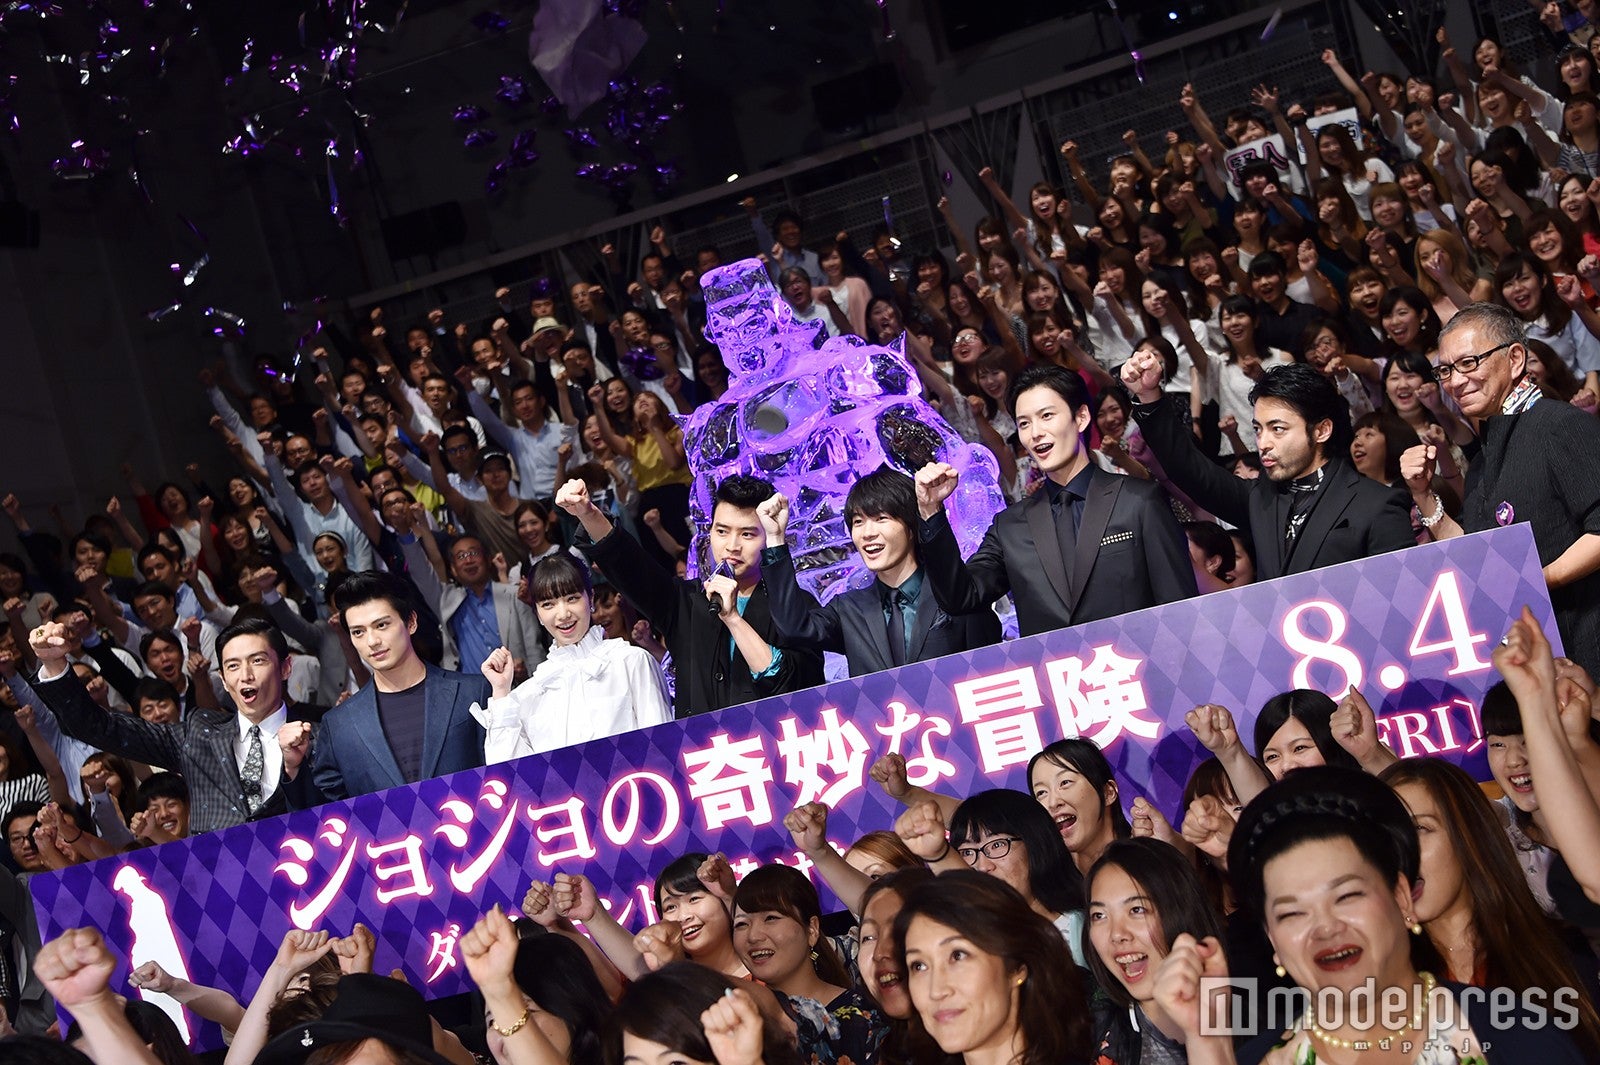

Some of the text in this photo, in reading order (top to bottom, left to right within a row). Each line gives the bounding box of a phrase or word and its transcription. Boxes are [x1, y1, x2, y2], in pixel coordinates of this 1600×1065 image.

[1282, 571, 1491, 701] 8.4
[273, 644, 1160, 931] ジョジョの奇妙な冒険
